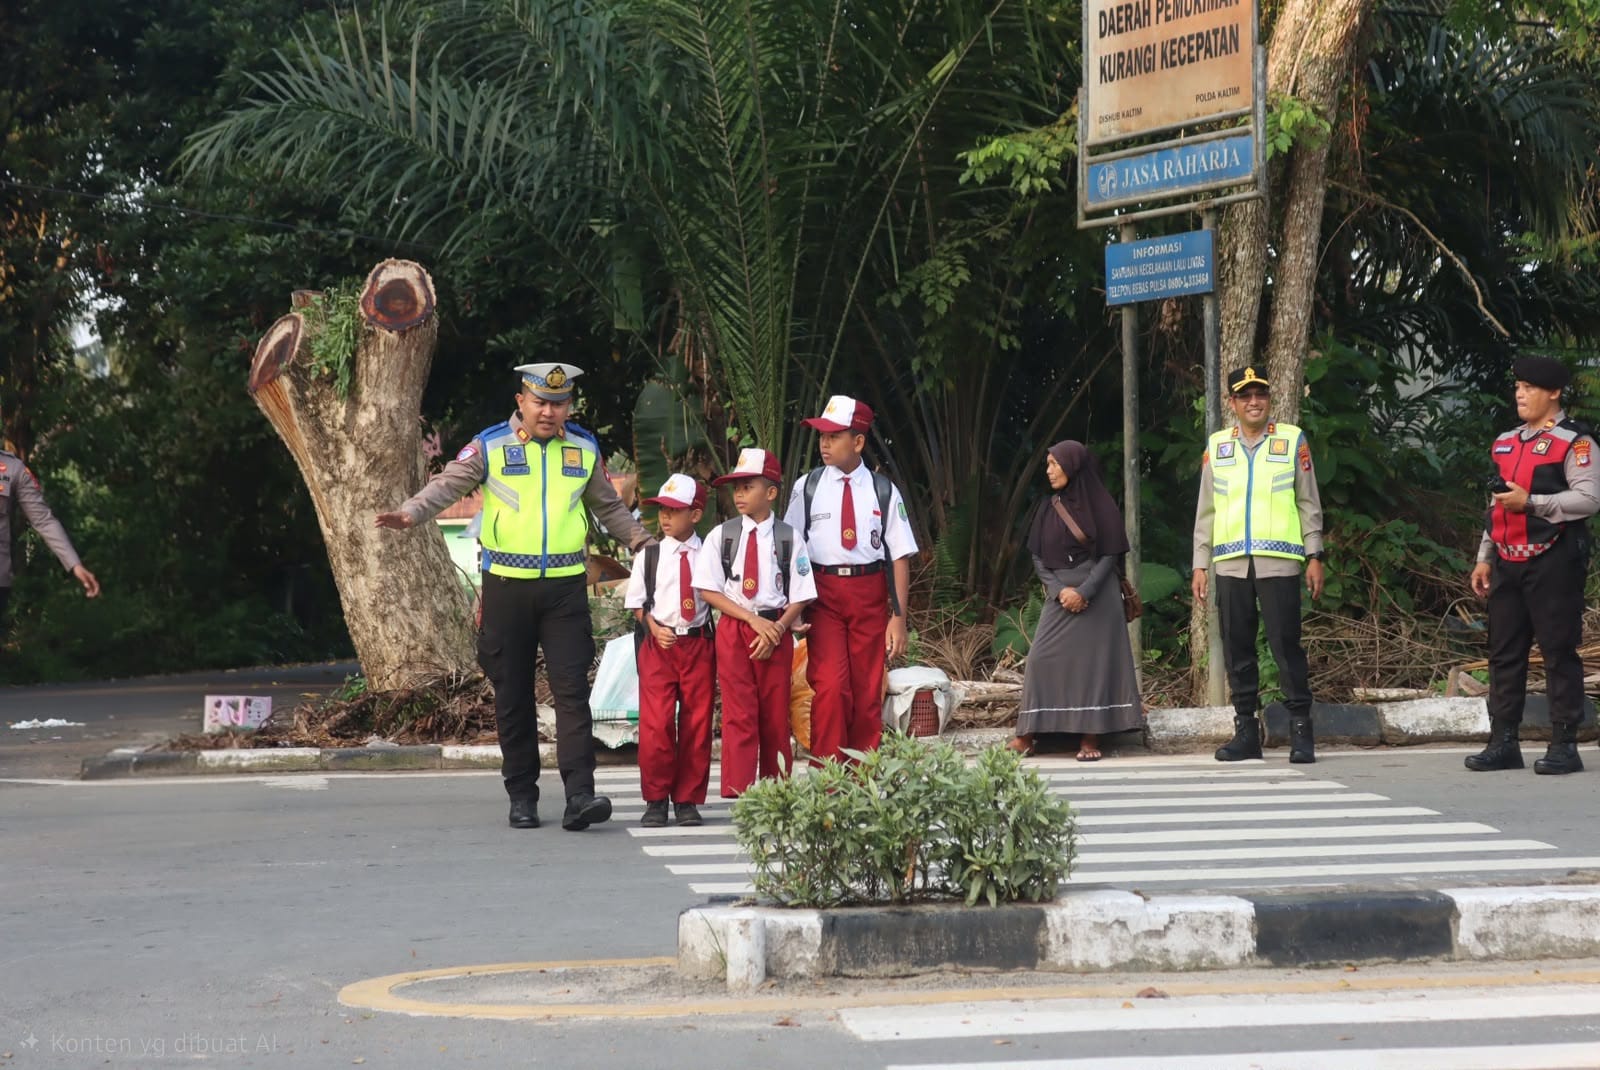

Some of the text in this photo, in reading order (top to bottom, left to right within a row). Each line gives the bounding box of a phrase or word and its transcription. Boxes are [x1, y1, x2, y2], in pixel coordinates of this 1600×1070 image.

[1099, 0, 1151, 39] DAERAH
[1100, 23, 1239, 85] KURANGI KECEPATAN
[1195, 86, 1240, 104] POLDA KALTIM
[1099, 107, 1142, 124] DISHUB KALTIM
[1122, 148, 1240, 188] JASA RAHARJA
[1133, 241, 1182, 260] INFORMASI
[1149, 279, 1167, 292] PULSA
